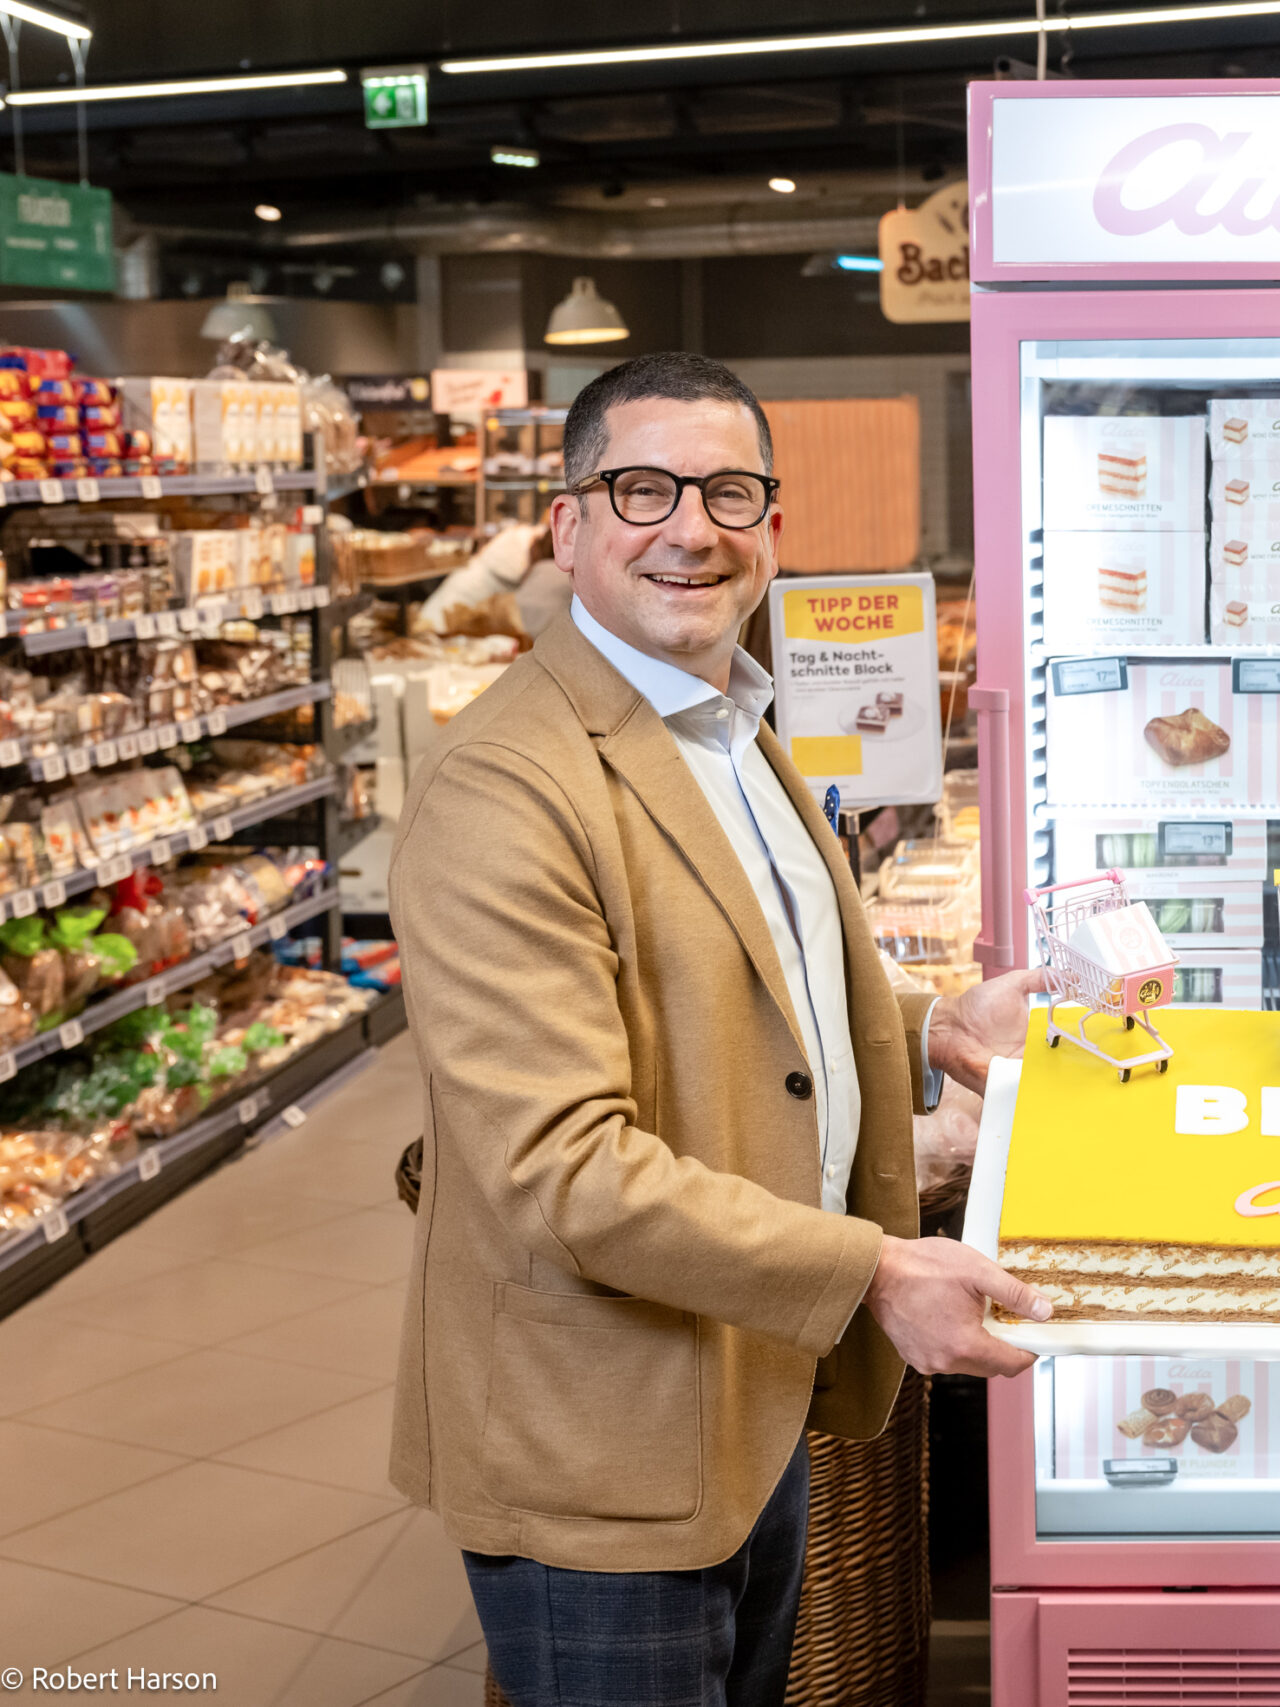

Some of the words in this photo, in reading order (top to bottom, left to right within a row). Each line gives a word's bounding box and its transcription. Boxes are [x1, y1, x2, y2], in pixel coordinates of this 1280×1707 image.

[807, 597, 853, 614] TIPP
[858, 594, 899, 611] DER
[814, 614, 895, 632] WOCHE
[789, 651, 816, 665] Tag
[819, 651, 829, 663] &
[833, 649, 885, 662] Nacht-
[790, 664, 850, 678] schnitte
[854, 662, 893, 676] Block
